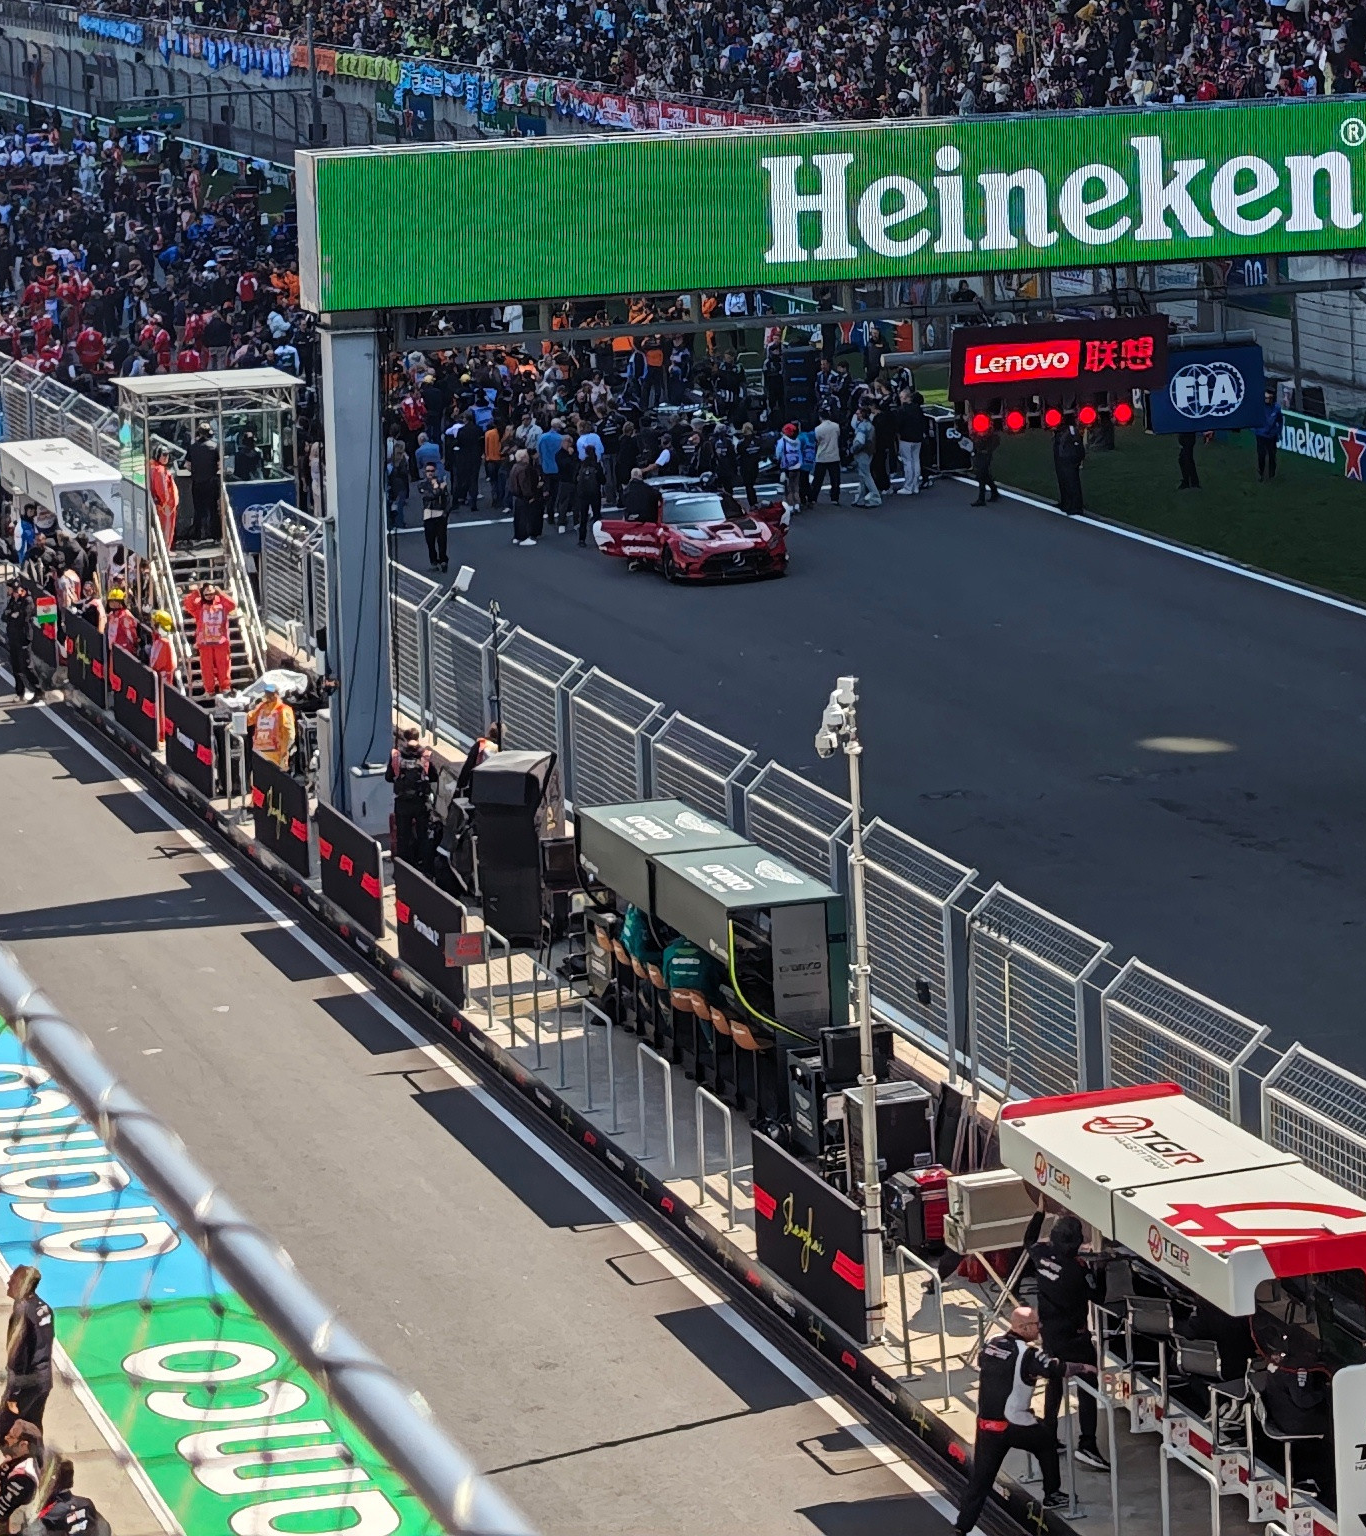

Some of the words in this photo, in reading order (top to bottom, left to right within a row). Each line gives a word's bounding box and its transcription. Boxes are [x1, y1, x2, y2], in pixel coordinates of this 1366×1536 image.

[974, 351, 1070, 375] Lenovo
[1085, 336, 1154, 372] 联想
[1276, 416, 1335, 463] ineken
[1132, 1129, 1205, 1166] TGR
[1047, 1163, 1071, 1190] TGR
[1163, 1237, 1191, 1267] TGR
